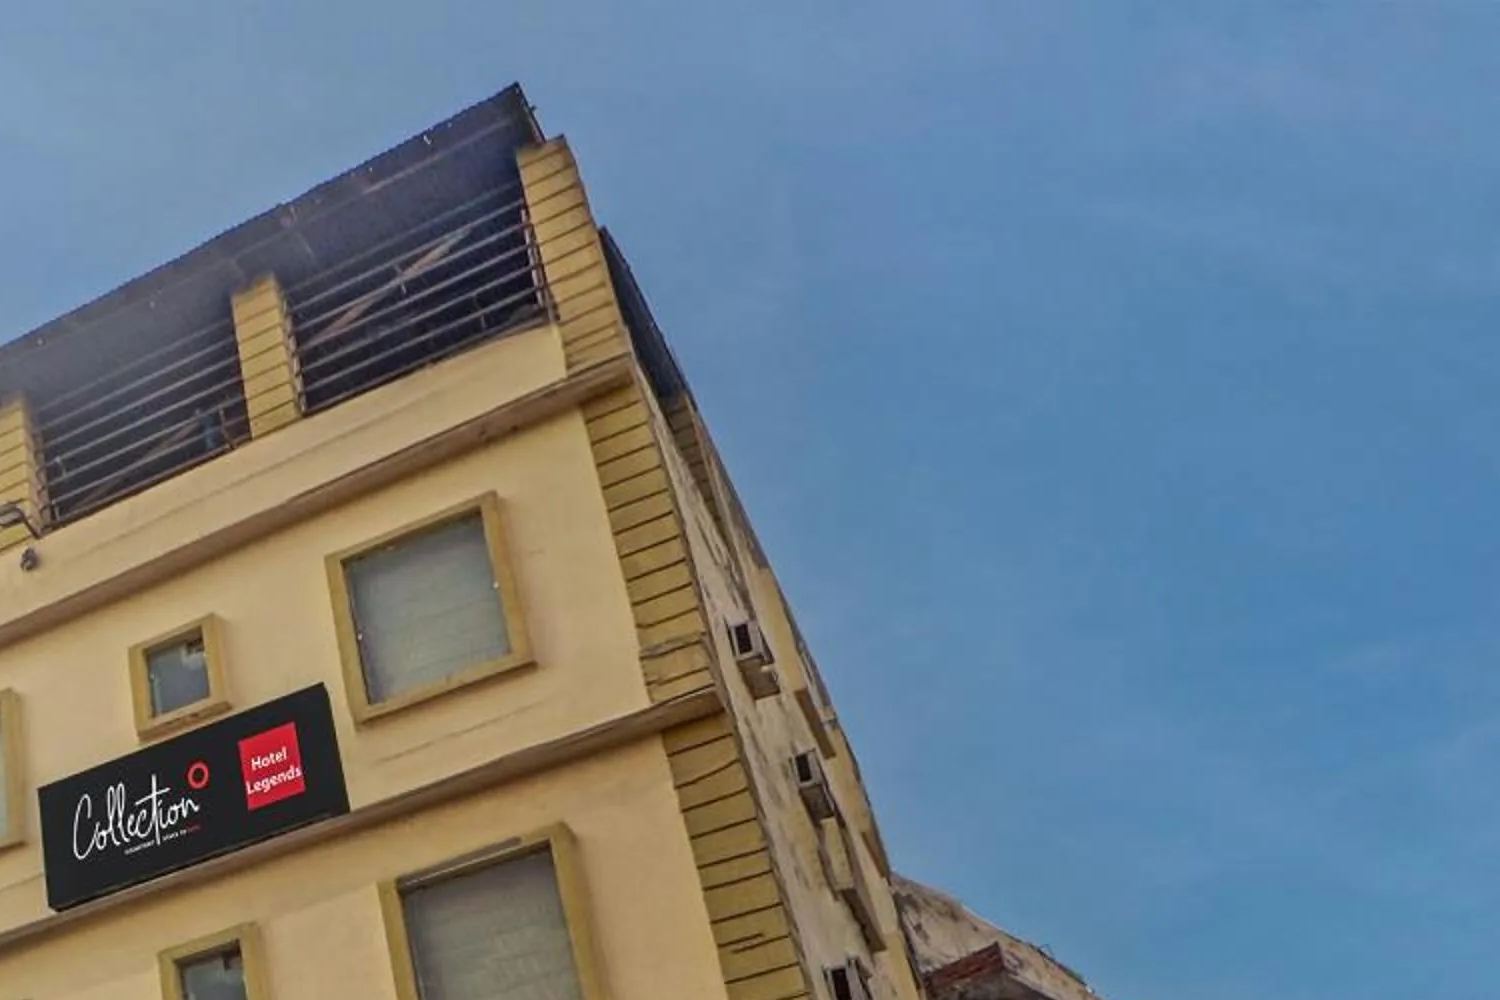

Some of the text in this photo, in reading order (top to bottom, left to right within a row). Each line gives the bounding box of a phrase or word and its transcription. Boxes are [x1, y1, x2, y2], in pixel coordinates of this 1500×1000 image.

[251, 747, 288, 770] Hotel
[246, 765, 302, 795] Legends
[72, 773, 200, 860] Collection
